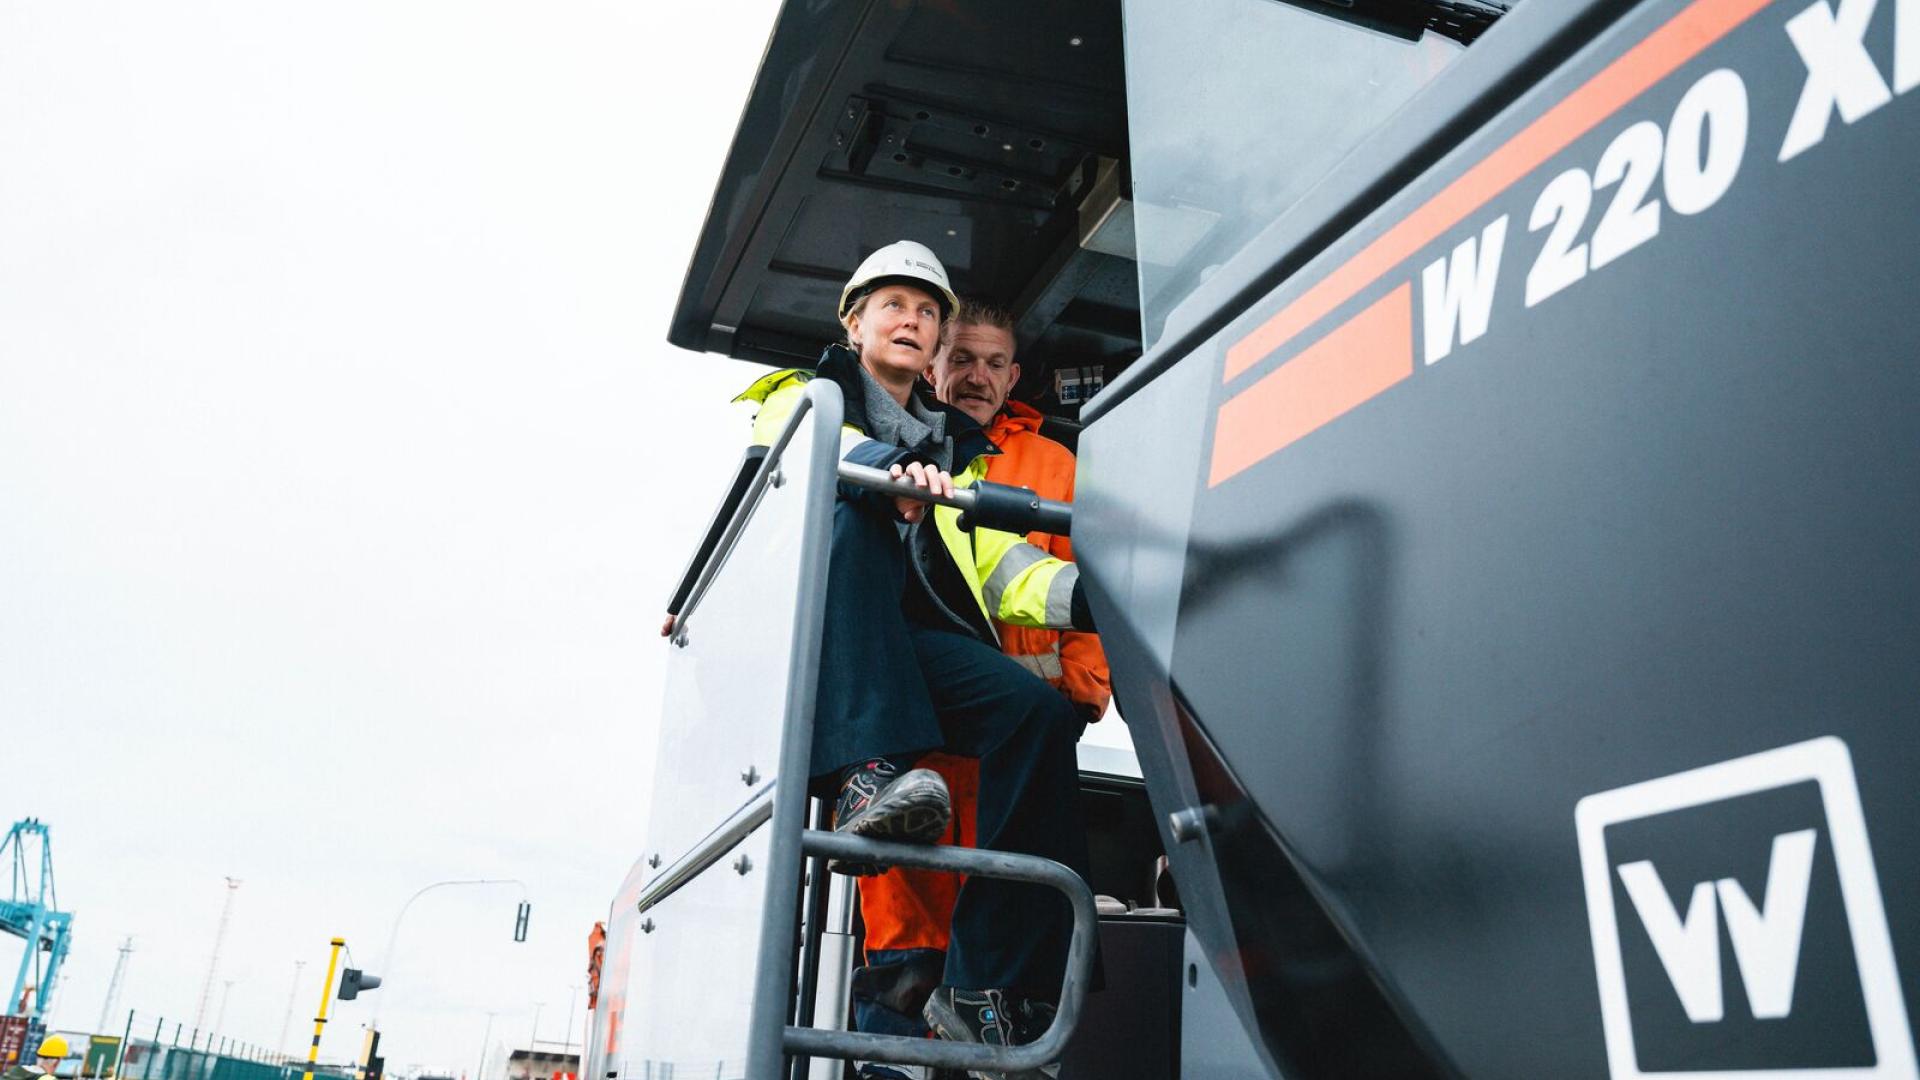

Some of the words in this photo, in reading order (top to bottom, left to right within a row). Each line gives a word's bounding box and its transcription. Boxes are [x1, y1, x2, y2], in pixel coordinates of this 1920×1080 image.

[1421, 213, 1509, 366] W
[1524, 68, 1748, 308] 220
[1617, 828, 1816, 1023] W
